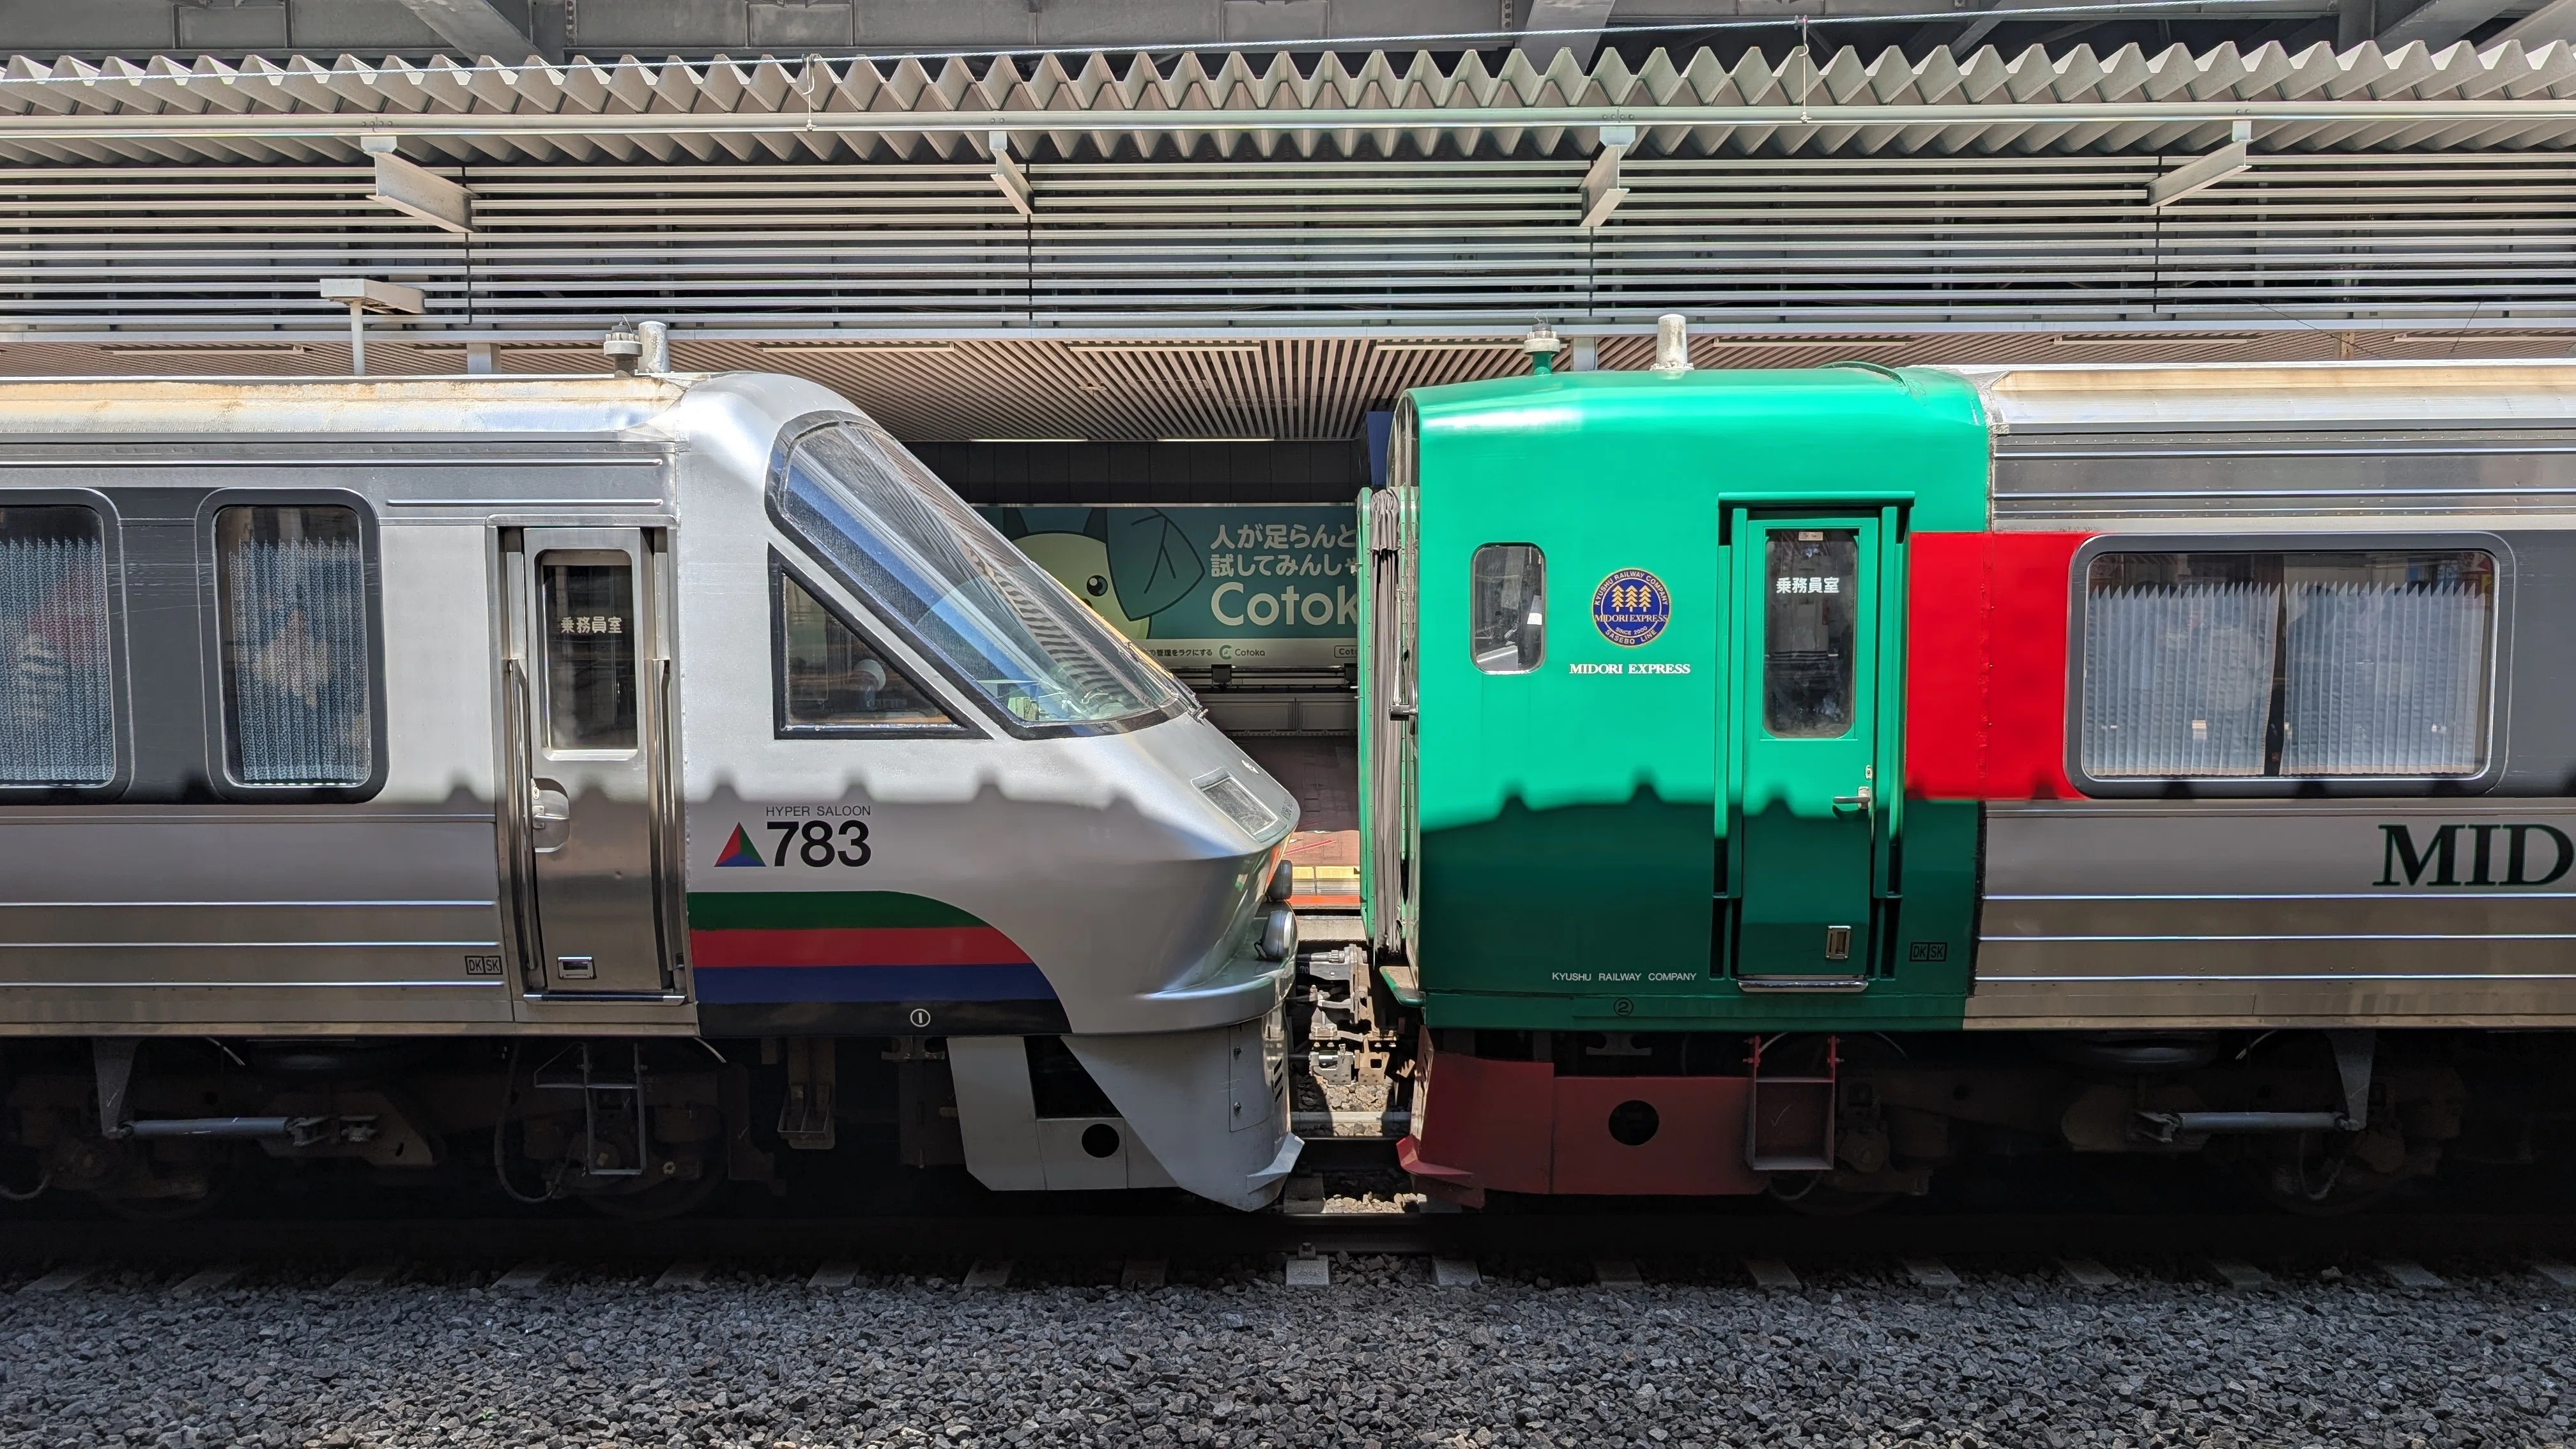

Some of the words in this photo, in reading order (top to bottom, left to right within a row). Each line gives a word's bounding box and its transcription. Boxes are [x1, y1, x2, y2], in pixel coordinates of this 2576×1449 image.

[1211, 523, 1356, 549] 人が足らんと
[1594, 578, 1613, 606] KYUSHU
[1614, 571, 1645, 581] RAILWAY
[1646, 575, 1668, 606] COMPANY
[1776, 577, 1840, 594] 乗務員室
[561, 617, 622, 633] 乗務員室
[1595, 614, 1629, 622] MIDORI
[1630, 614, 1667, 622] EXPRESS
[1605, 629, 1635, 645] SASEBO
[1640, 629, 1657, 642] LINE
[1569, 663, 1623, 675] MIDORI
[1628, 663, 1691, 675] EXPRESS
[766, 806, 810, 816] HYPER
[816, 805, 871, 816] SALOON
[767, 820, 871, 868] 783
[2372, 824, 2575, 887] MID
[1552, 972, 1591, 981] KYUSHU
[1598, 972, 1642, 981] RAILWAY
[1648, 972, 1697, 981] COMPANY
